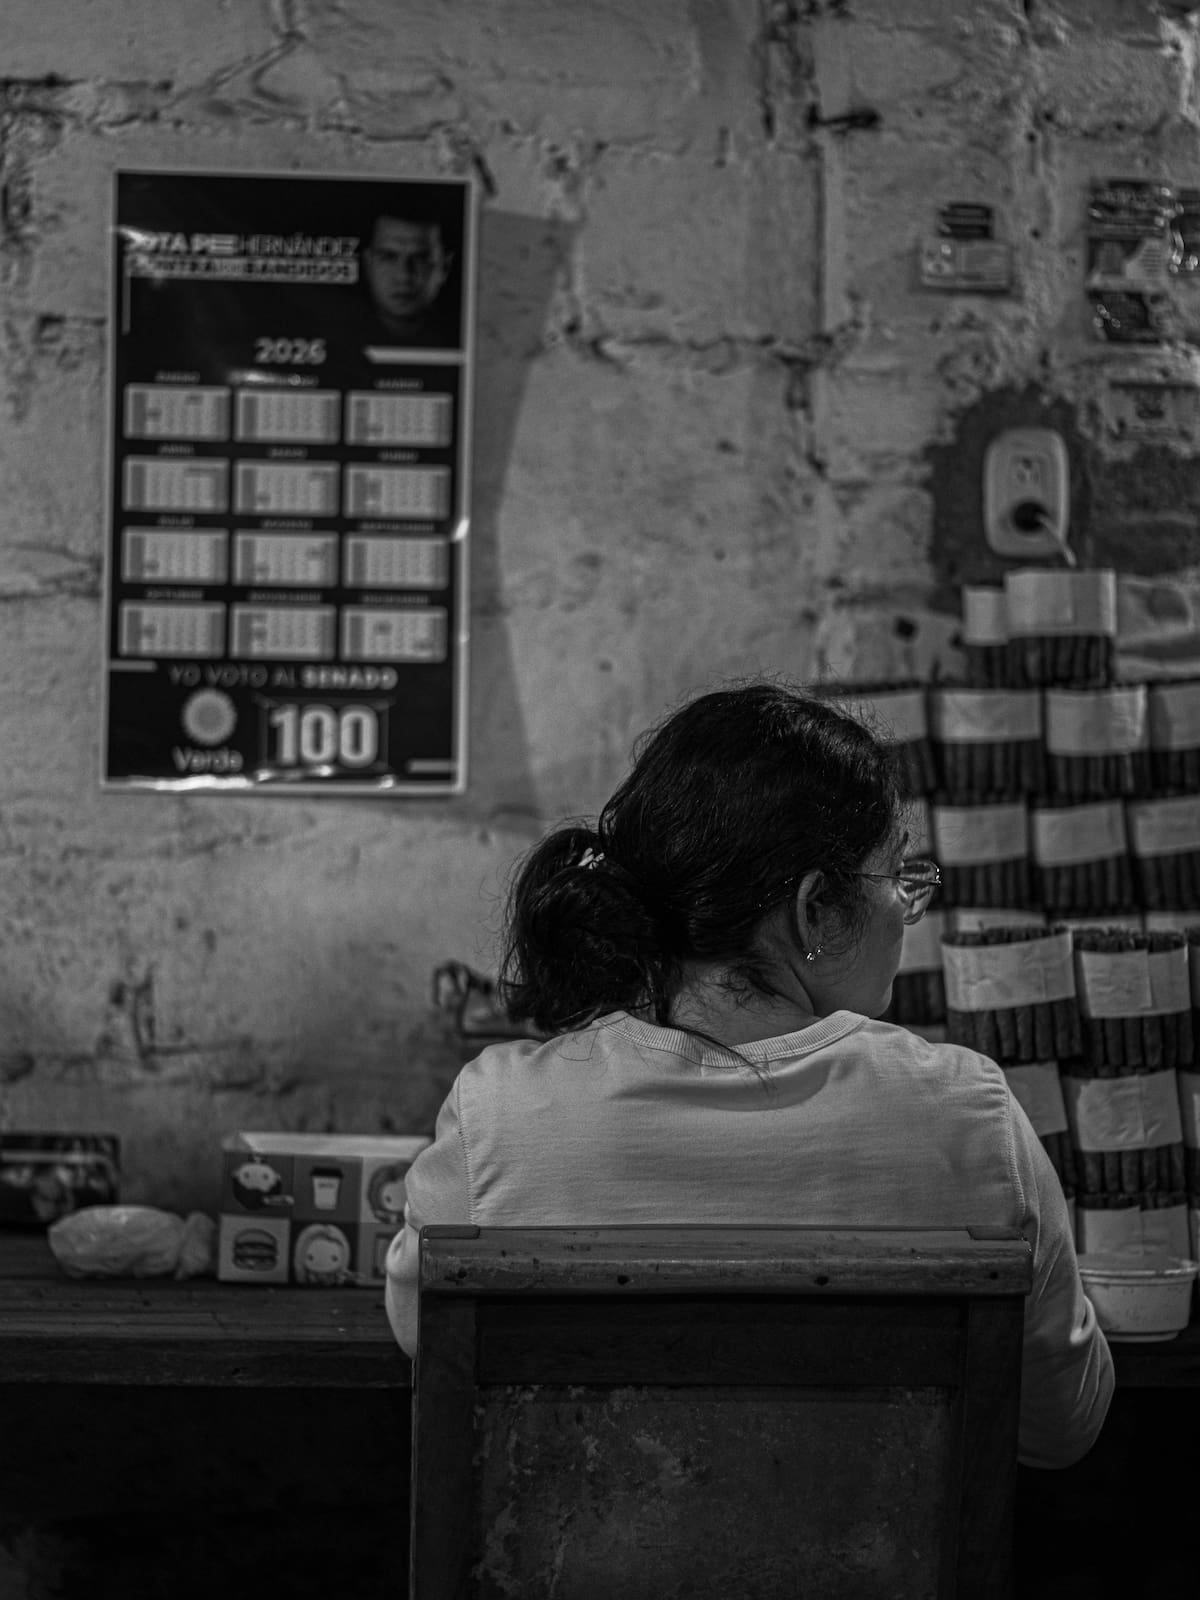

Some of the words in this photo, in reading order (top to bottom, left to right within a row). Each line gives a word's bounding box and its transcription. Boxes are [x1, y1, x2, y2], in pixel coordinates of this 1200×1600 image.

[255, 338, 327, 365] 2026
[170, 665, 201, 686] YO
[206, 665, 267, 687] VOTO
[272, 666, 297, 687] AL
[301, 665, 399, 689] SENADO
[270, 704, 379, 766] 100
[173, 747, 243, 772] Verde
